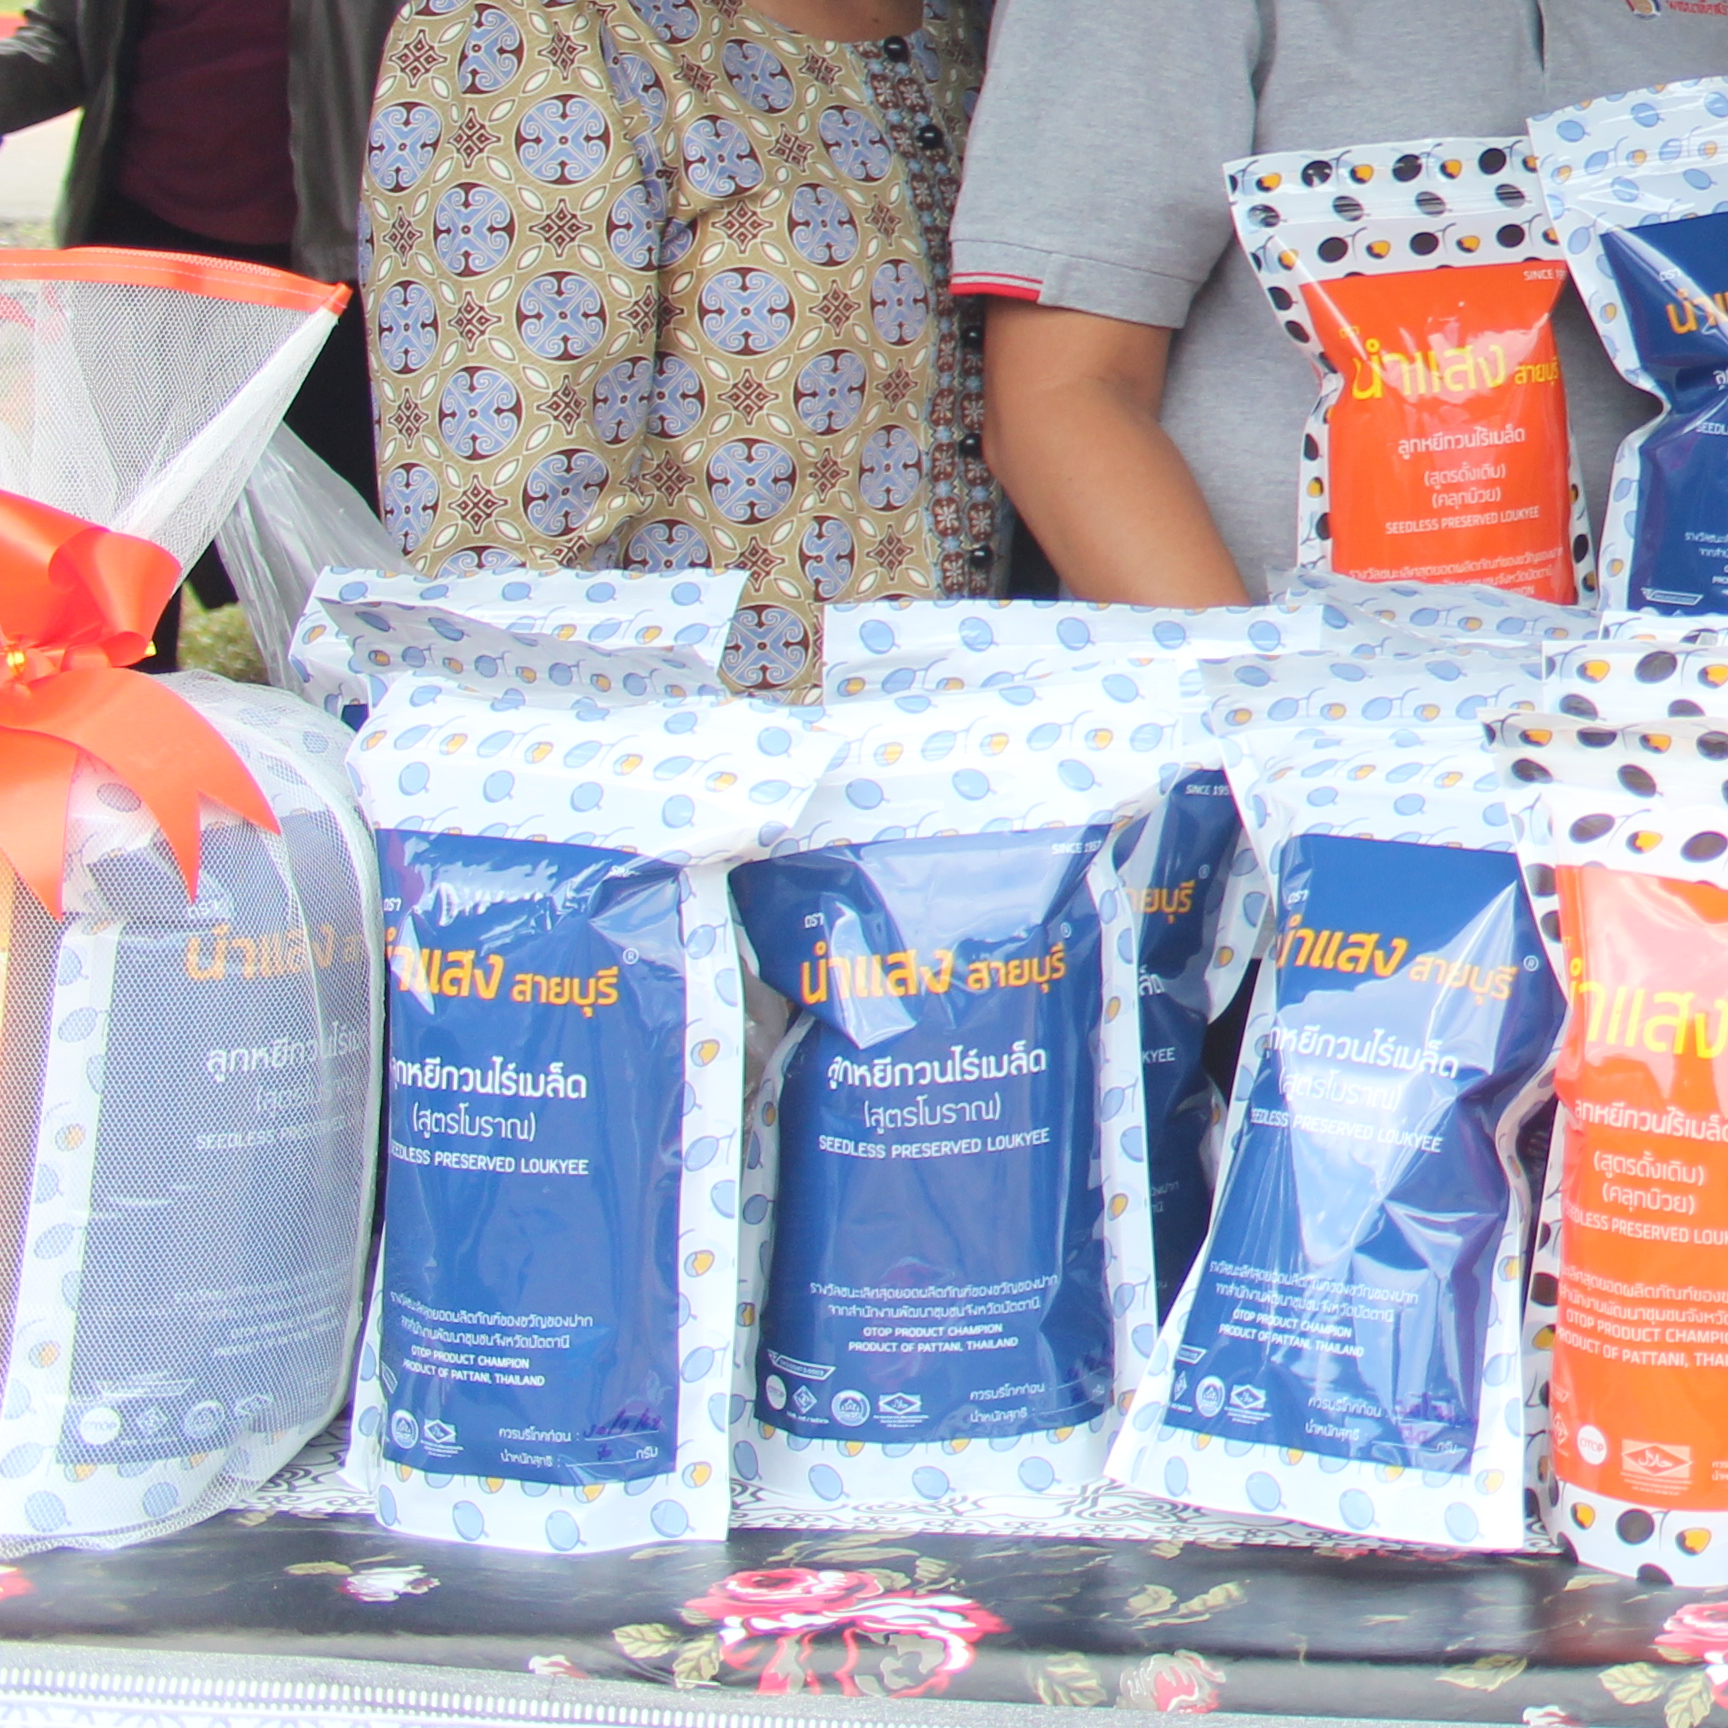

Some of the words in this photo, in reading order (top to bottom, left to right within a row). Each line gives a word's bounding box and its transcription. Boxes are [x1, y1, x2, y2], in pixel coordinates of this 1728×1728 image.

[1351, 338, 1507, 400] นำแสง
[1386, 518, 1439, 535] SEEDLESS
[1441, 511, 1498, 530] PRESERVED
[1185, 783, 1211, 796] SINCE
[1051, 841, 1083, 855] SINCE
[804, 912, 824, 929] ตรา
[801, 940, 954, 1004] นำแสง
[966, 942, 1067, 994] สายบุรี
[1408, 954, 1519, 1006] สายบุรี
[510, 965, 620, 1019] สายบุรี
[828, 1040, 1046, 1090] ลูกหยีกวนไร้เมล็ด
[412, 1101, 537, 1143] (สูตรโบราณ)
[864, 1092, 1001, 1134] (สูตรโบราณ)
[819, 1135, 886, 1159] SEEDLESS
[891, 1138, 982, 1159] PRESERVED
[987, 1128, 1050, 1152] LOUKYEE
[1293, 1114, 1374, 1141] PRESERVED
[1377, 1123, 1443, 1154] LOUKYEE
[434, 1149, 515, 1173] PRESERVED
[521, 1157, 589, 1176] LOUKYEE
[1593, 1149, 1704, 1187] (สูตรดั้งเดิม)
[1611, 1217, 1689, 1243] PRESERVED
[863, 1325, 893, 1338] OTOP
[894, 1325, 945, 1338] PRODUCT
[947, 1323, 1003, 1336] CHAMPION
[1256, 1312, 1299, 1330] PRODUCT
[1301, 1320, 1352, 1340] CHAMPION
[1566, 1309, 1596, 1331] OTOP
[1598, 1320, 1663, 1344] PRODUCT
[848, 1341, 898, 1353] PRODUCT
[900, 1341, 915, 1353] OF
[966, 1337, 1019, 1351] THAILAND
[1218, 1324, 1256, 1341] PRODUCT
[1258, 1331, 1270, 1342] OF
[1314, 1339, 1364, 1358] THAILAND
[433, 1349, 475, 1366] PRODUCT
[478, 1354, 530, 1370] CHAMPION
[1602, 1344, 1619, 1360] OF
[1621, 1350, 1690, 1369] PATTANI,
[438, 1368, 449, 1379] OF
[494, 1373, 545, 1387] THAILAND
